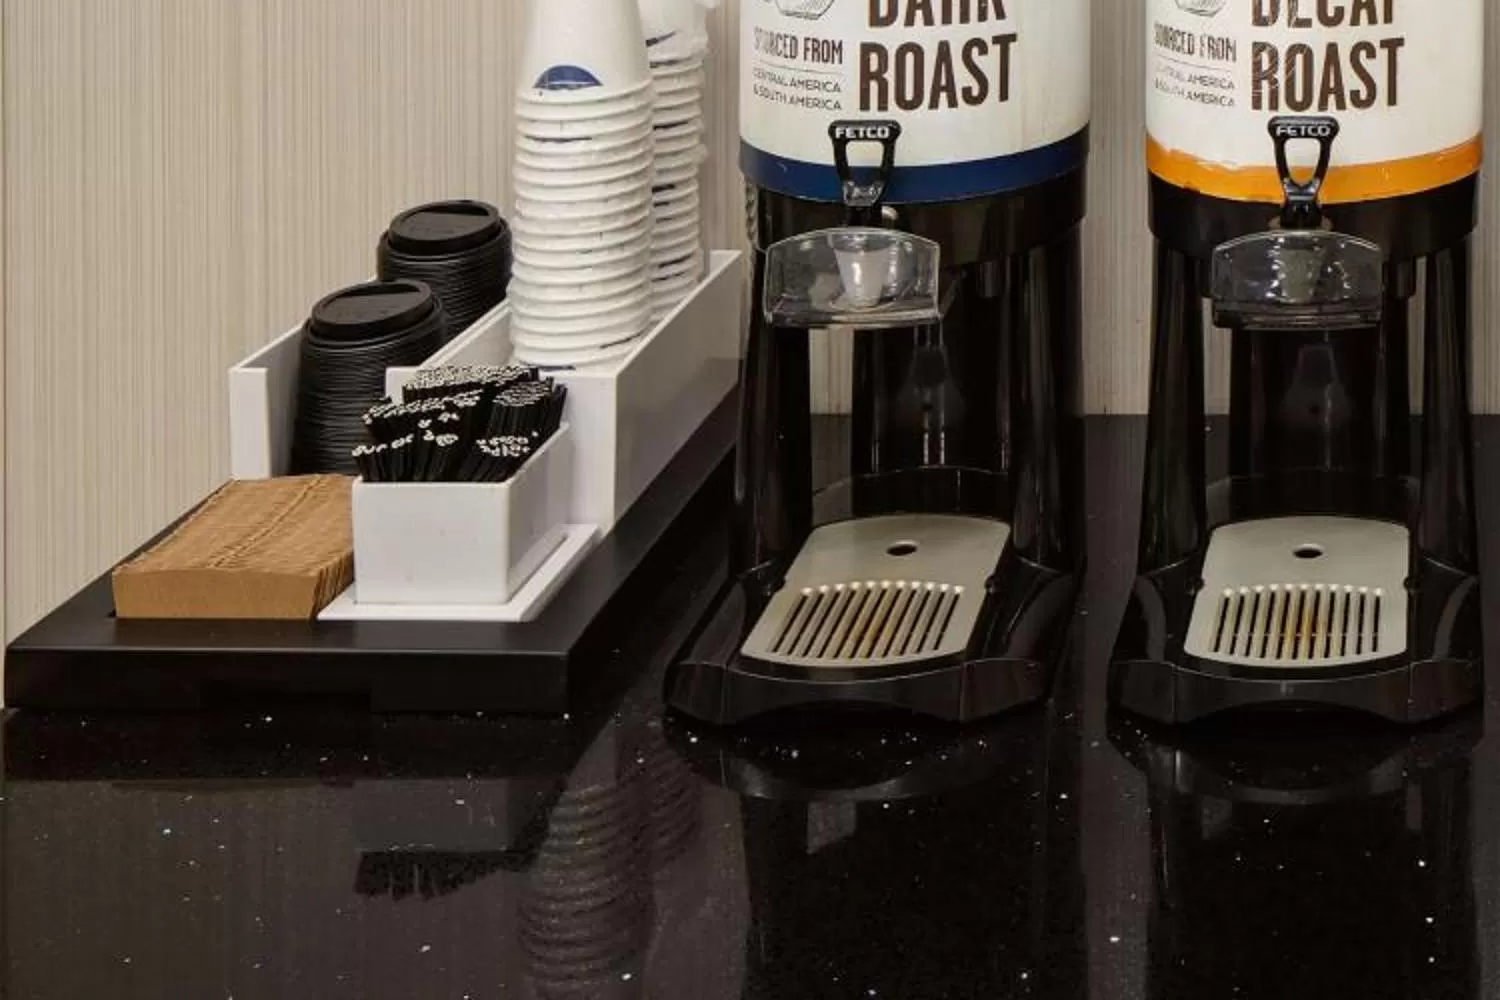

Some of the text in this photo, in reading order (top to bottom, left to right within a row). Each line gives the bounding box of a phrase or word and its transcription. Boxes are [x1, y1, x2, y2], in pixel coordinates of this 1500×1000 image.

[803, 36, 843, 65] FROM
[859, 33, 1018, 112] ROAST
[1250, 36, 1405, 112] ROAST
[789, 78, 843, 94] AMERICA
[788, 94, 843, 111] AMERICA
[835, 126, 889, 139] FETCO
[1276, 125, 1331, 138] FETCO
